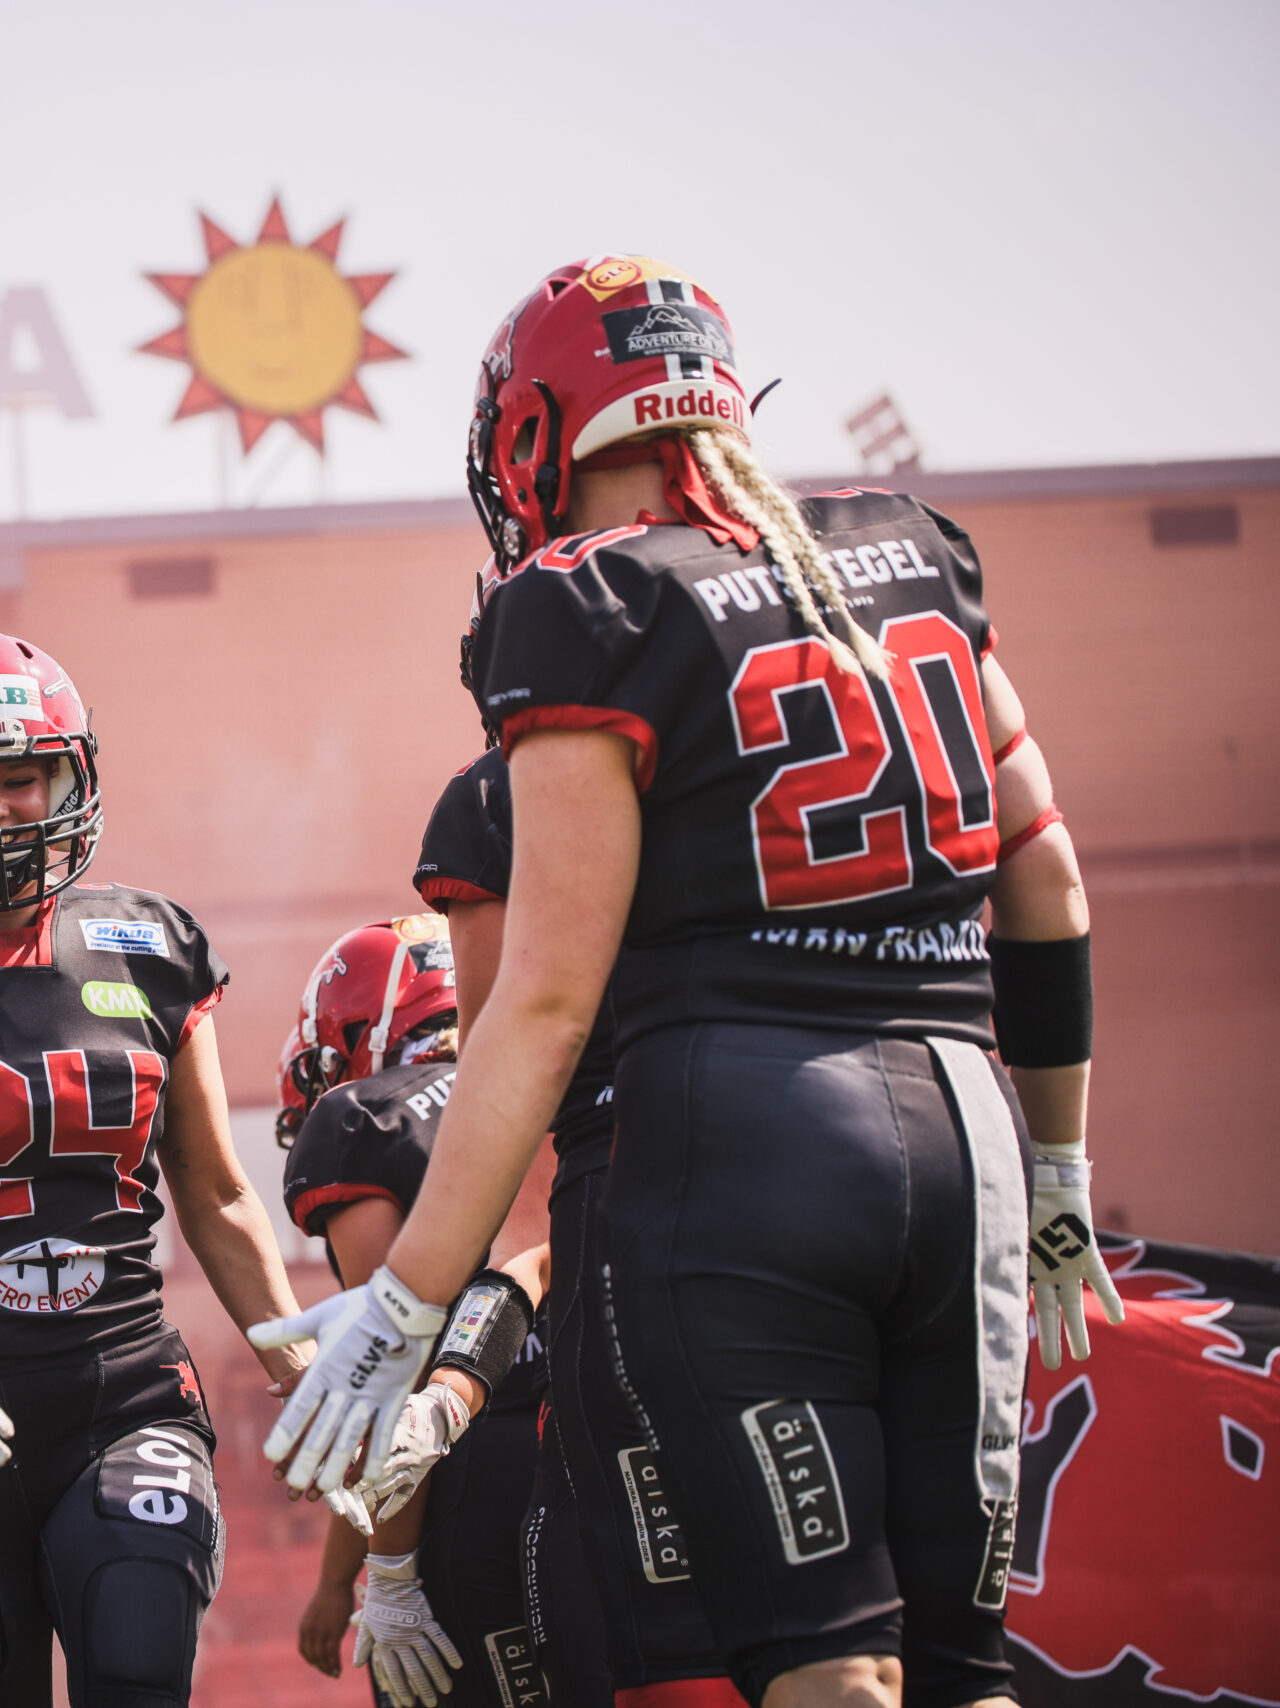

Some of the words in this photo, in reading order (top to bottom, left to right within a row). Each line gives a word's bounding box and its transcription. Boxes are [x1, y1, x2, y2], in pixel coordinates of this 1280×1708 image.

[634, 388, 744, 428] Riddell
[727, 610, 999, 910] 20
[38, 1272, 98, 1311] EVENT
[349, 1336, 388, 1390] GLVS
[773, 1418, 827, 1538] älska
[624, 1471, 637, 1505] NATURAL
[641, 1540, 650, 1563] CIDER
